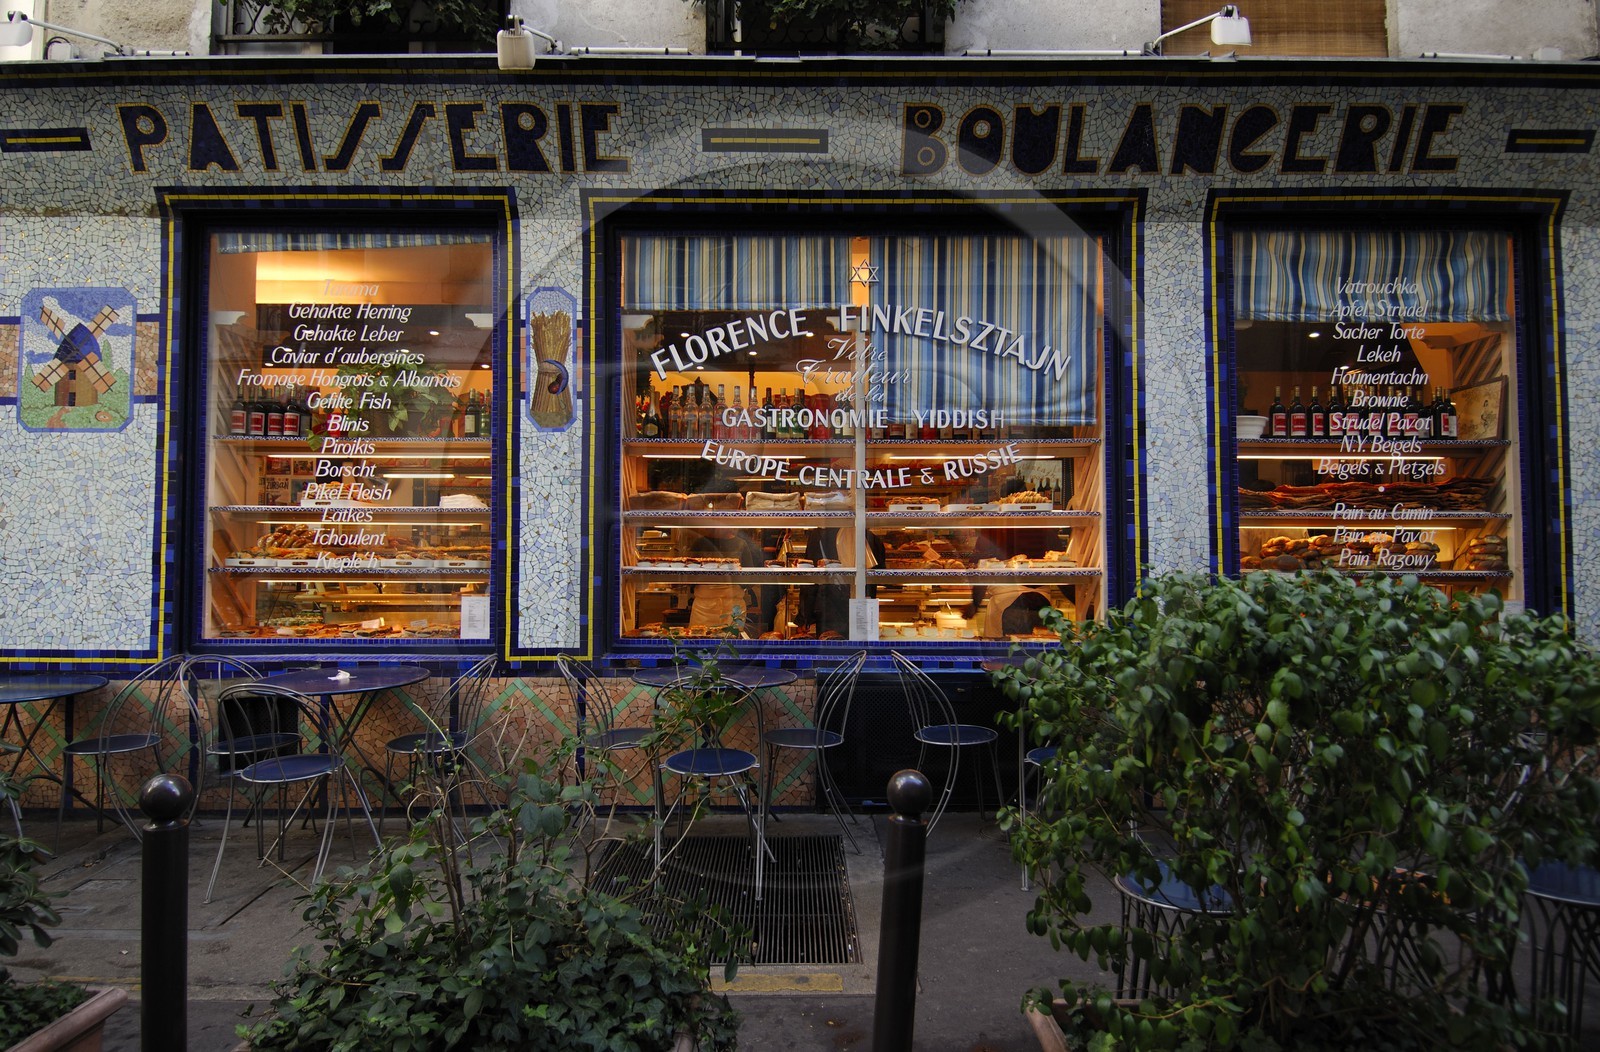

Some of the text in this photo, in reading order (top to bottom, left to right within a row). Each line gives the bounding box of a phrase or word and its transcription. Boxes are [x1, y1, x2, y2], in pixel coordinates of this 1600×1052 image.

[116, 101, 631, 174] PATISSERIE
[901, 101, 1469, 176] BOULANGERIE
[322, 279, 379, 297] Tarama
[1336, 277, 1418, 295] Vatrouchka
[289, 302, 412, 323] Gehakte Herring
[1330, 299, 1429, 319] Apfel Strudel
[294, 325, 404, 342] Gehakte Leber
[1332, 322, 1425, 340] Sacher Torte
[650, 304, 1072, 381] FLORENCE FINKELSZTAJN
[827, 338, 888, 361] Votre
[271, 347, 318, 364] Caviar
[1357, 345, 1401, 363] Lekeh
[237, 368, 461, 389] Fromage Hongrois & Albanais
[796, 359, 912, 384] Traiteur
[1331, 367, 1429, 385] Houmentachn
[307, 392, 392, 409] Gefilte Fish
[835, 384, 885, 402] de la
[1351, 389, 1409, 408] Brownie
[327, 415, 369, 432] Blinis
[721, 408, 1005, 429] GASTRONOMIE YIDDISH
[1329, 412, 1385, 431] Strudel
[1387, 413, 1432, 431] Pavot
[321, 437, 375, 456] Pirojkis
[1340, 435, 1422, 457] N.Y. Beigels
[315, 460, 376, 477] Borscht
[701, 439, 791, 482] EUROPE
[798, 465, 912, 489] CENTRALE
[920, 467, 935, 485] &
[943, 442, 1024, 481] RUSSIE
[1317, 458, 1445, 480] Beigels & Pletzels
[303, 483, 392, 500] Pikel Fleish
[321, 506, 373, 523] Latkes
[1332, 502, 1433, 520] Pain au Cumin
[313, 528, 386, 546] Tchoulent
[1333, 525, 1437, 543] Pain au Pavot
[1338, 548, 1435, 571] Pain Razowy
